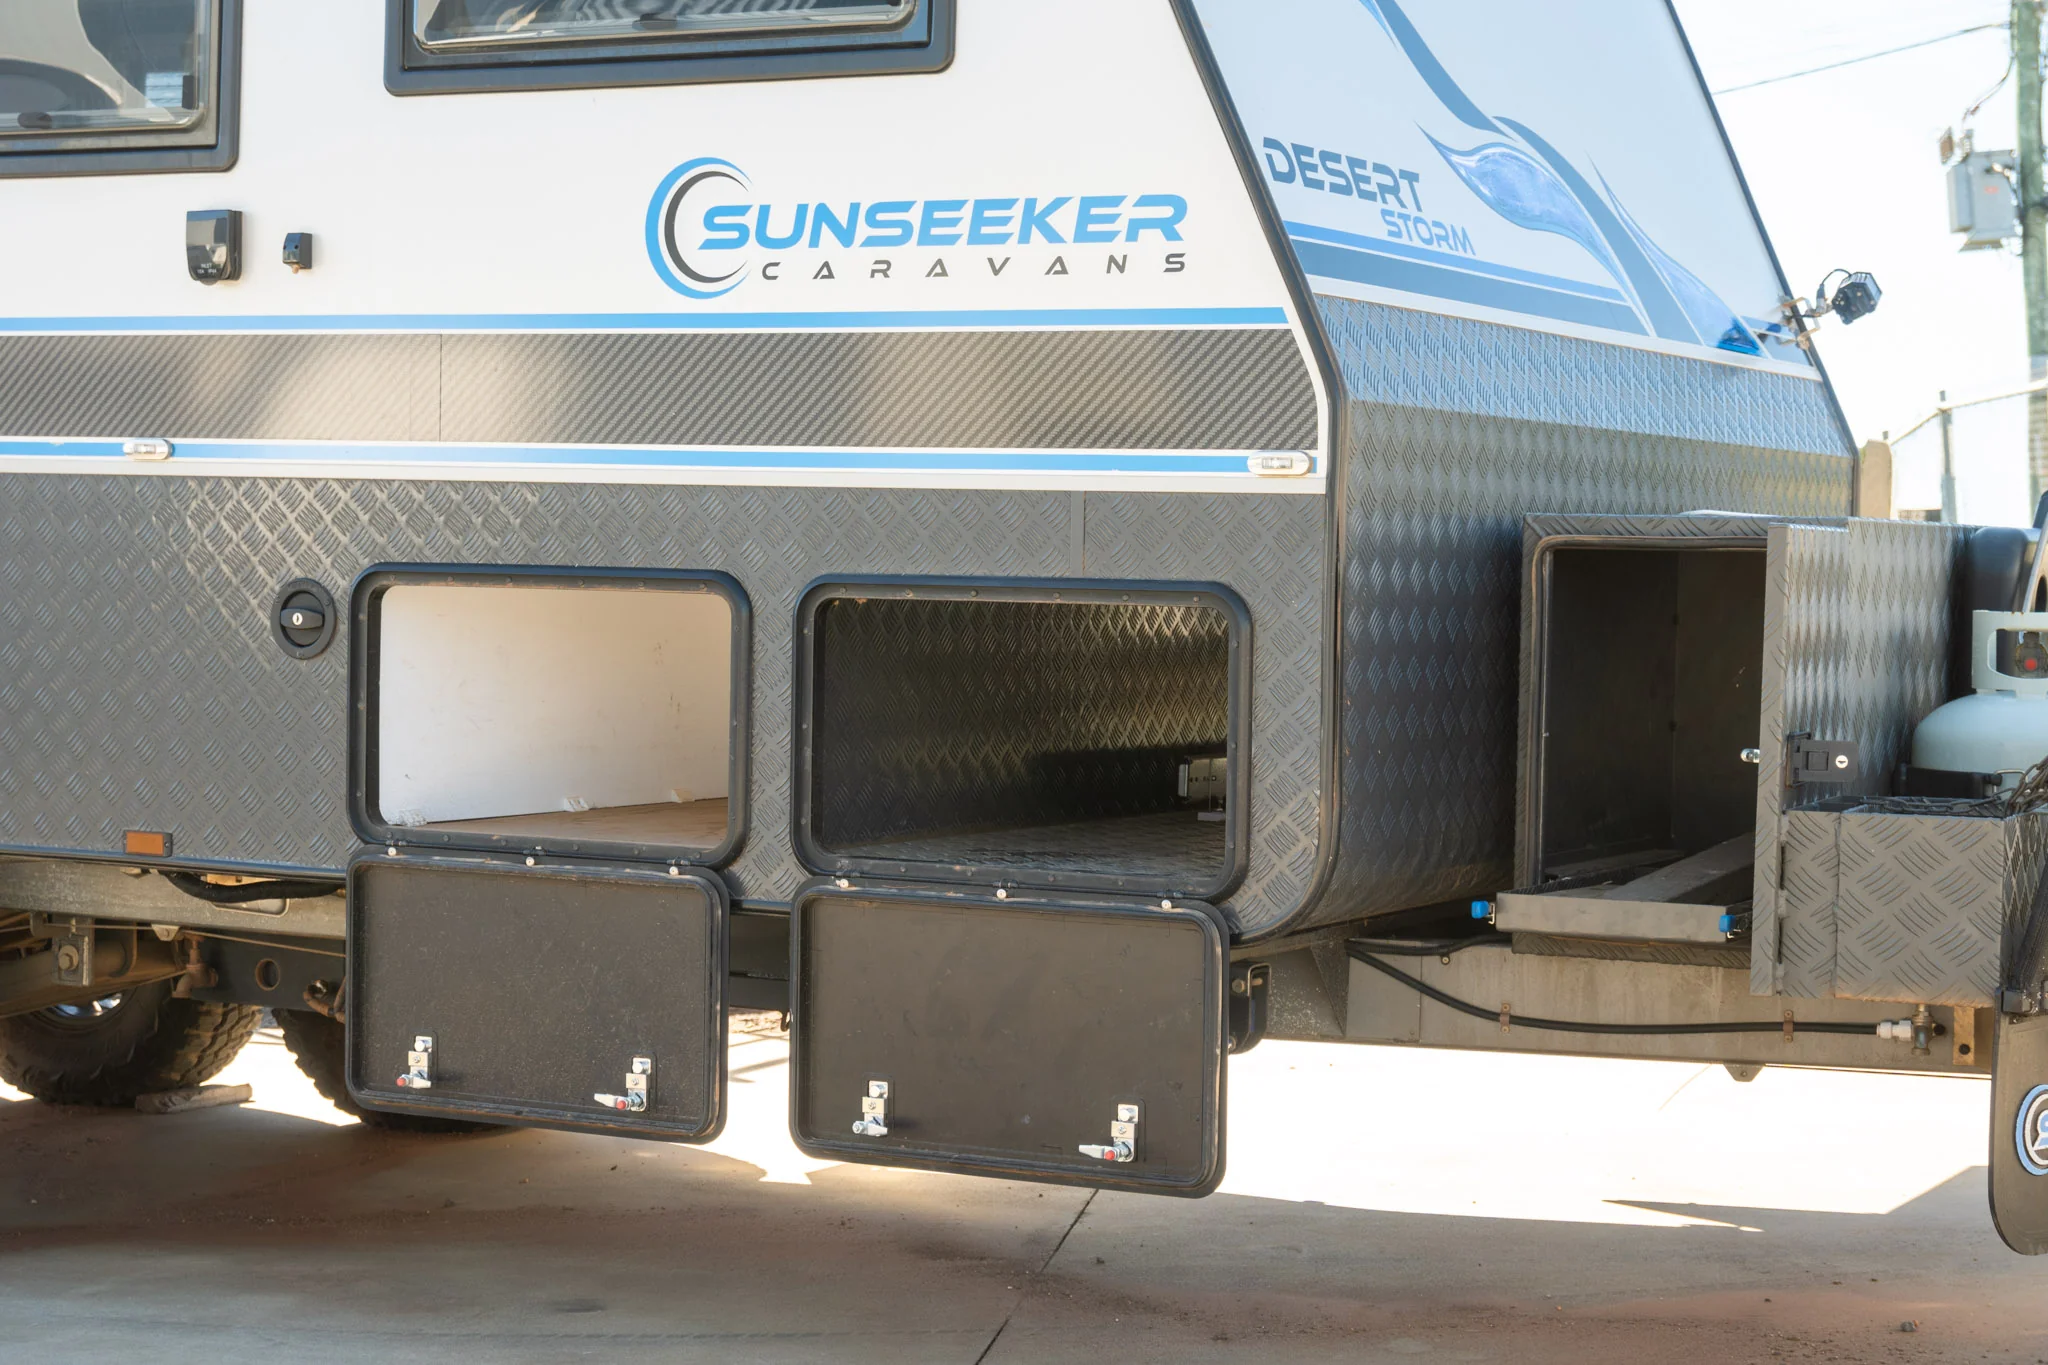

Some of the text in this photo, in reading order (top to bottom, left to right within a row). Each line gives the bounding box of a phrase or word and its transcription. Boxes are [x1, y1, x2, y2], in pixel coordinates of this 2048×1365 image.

[1263, 137, 1423, 212] DESERT
[697, 194, 1188, 250] SUNSEEKER
[1380, 208, 1476, 256] STORM
[762, 252, 1186, 281] CARAVANS
